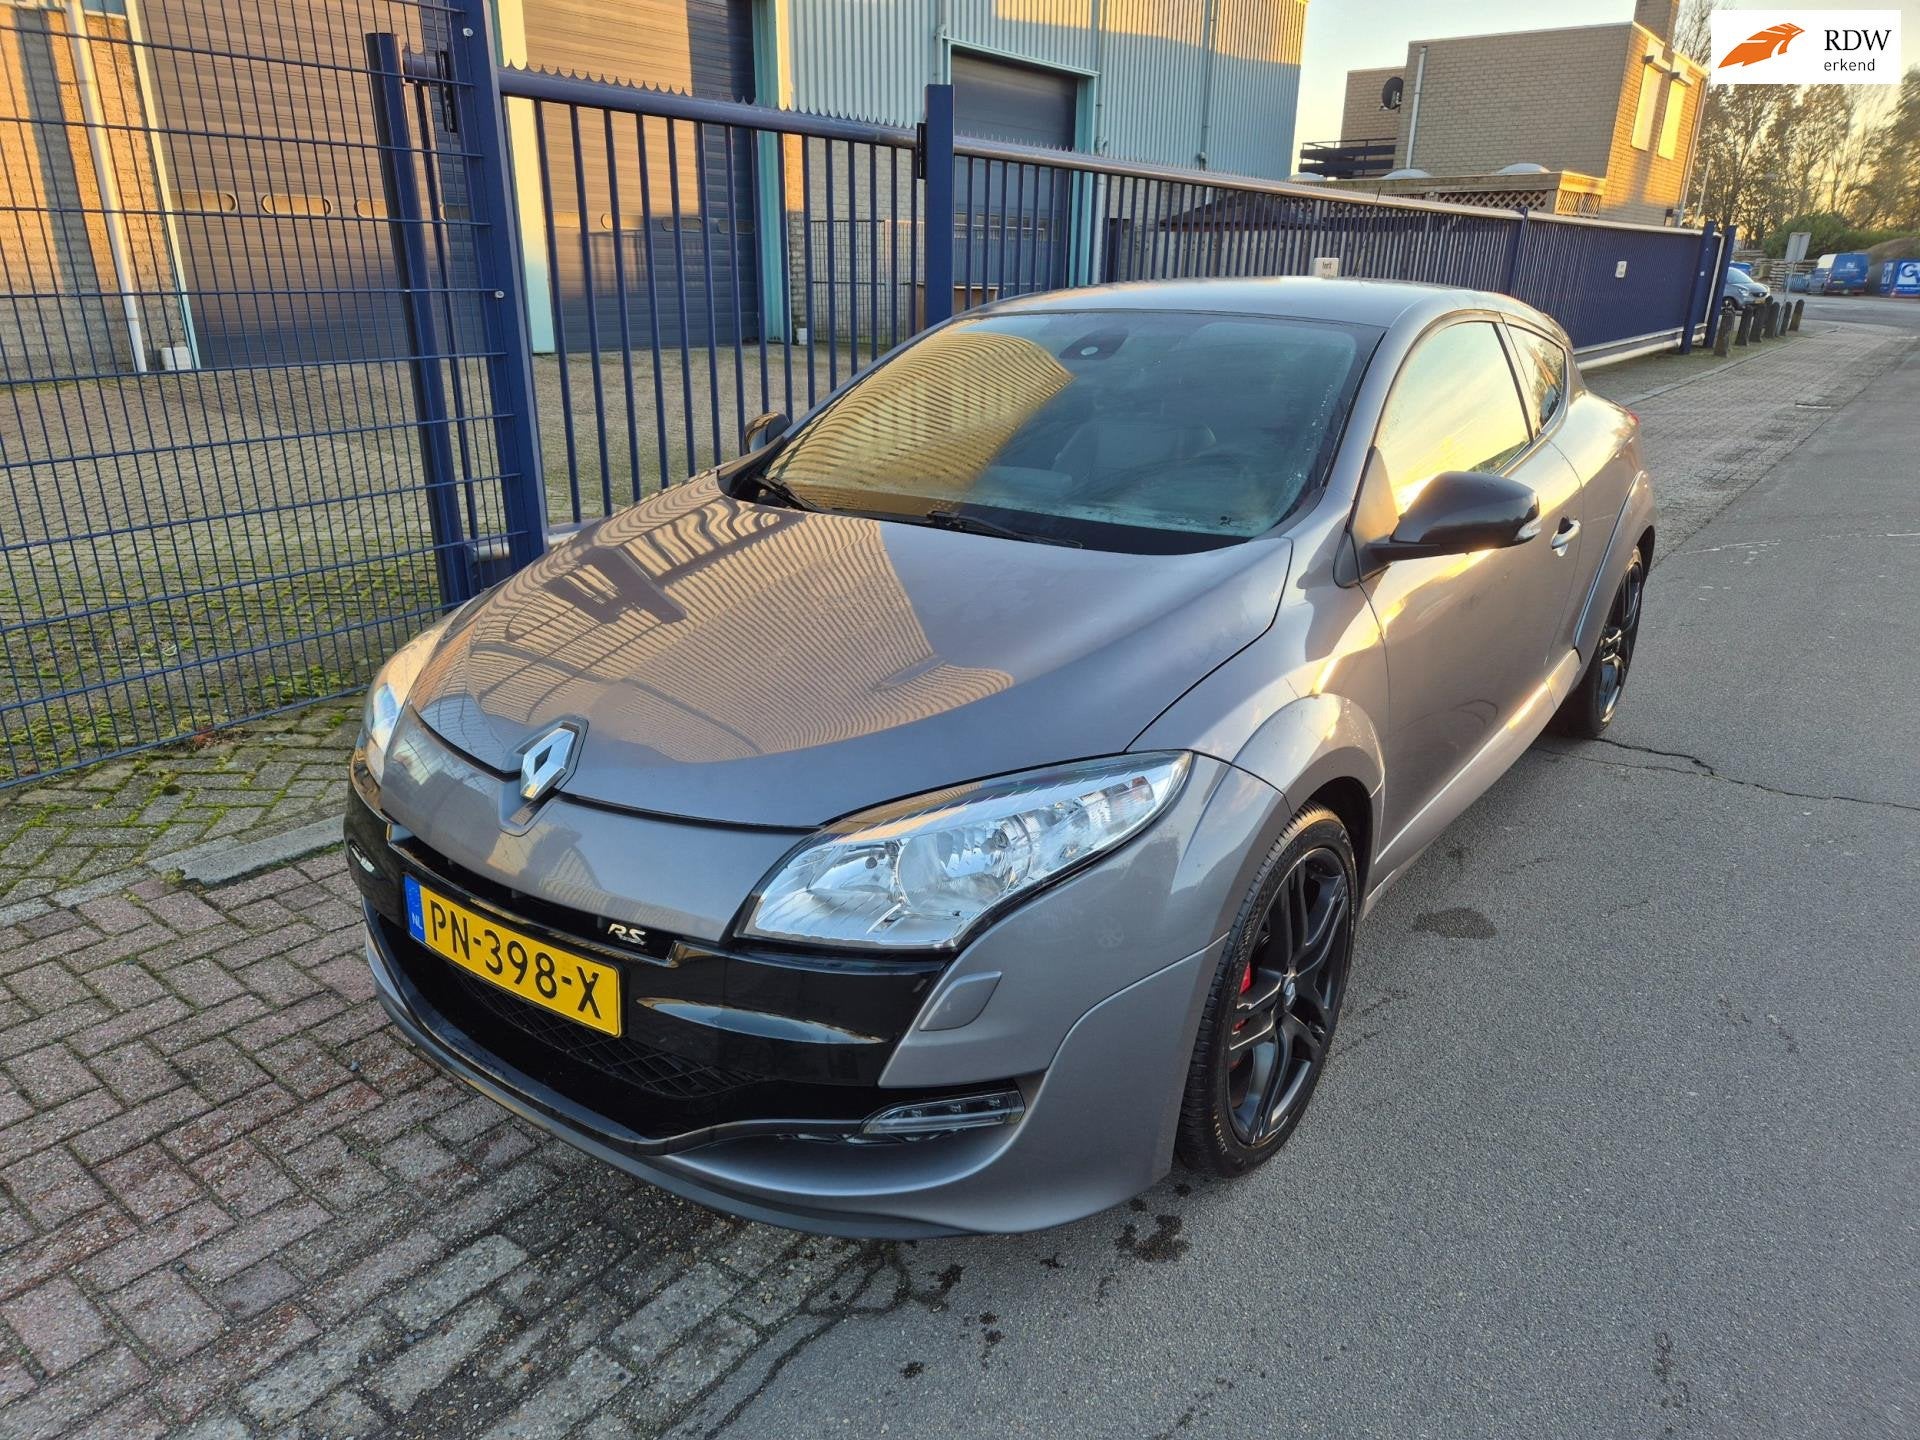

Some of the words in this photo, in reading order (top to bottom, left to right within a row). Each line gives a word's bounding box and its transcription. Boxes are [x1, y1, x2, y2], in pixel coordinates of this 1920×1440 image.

[411, 911, 424, 930] NL
[607, 923, 647, 946] RS
[430, 899, 602, 1020] PN-398-X
